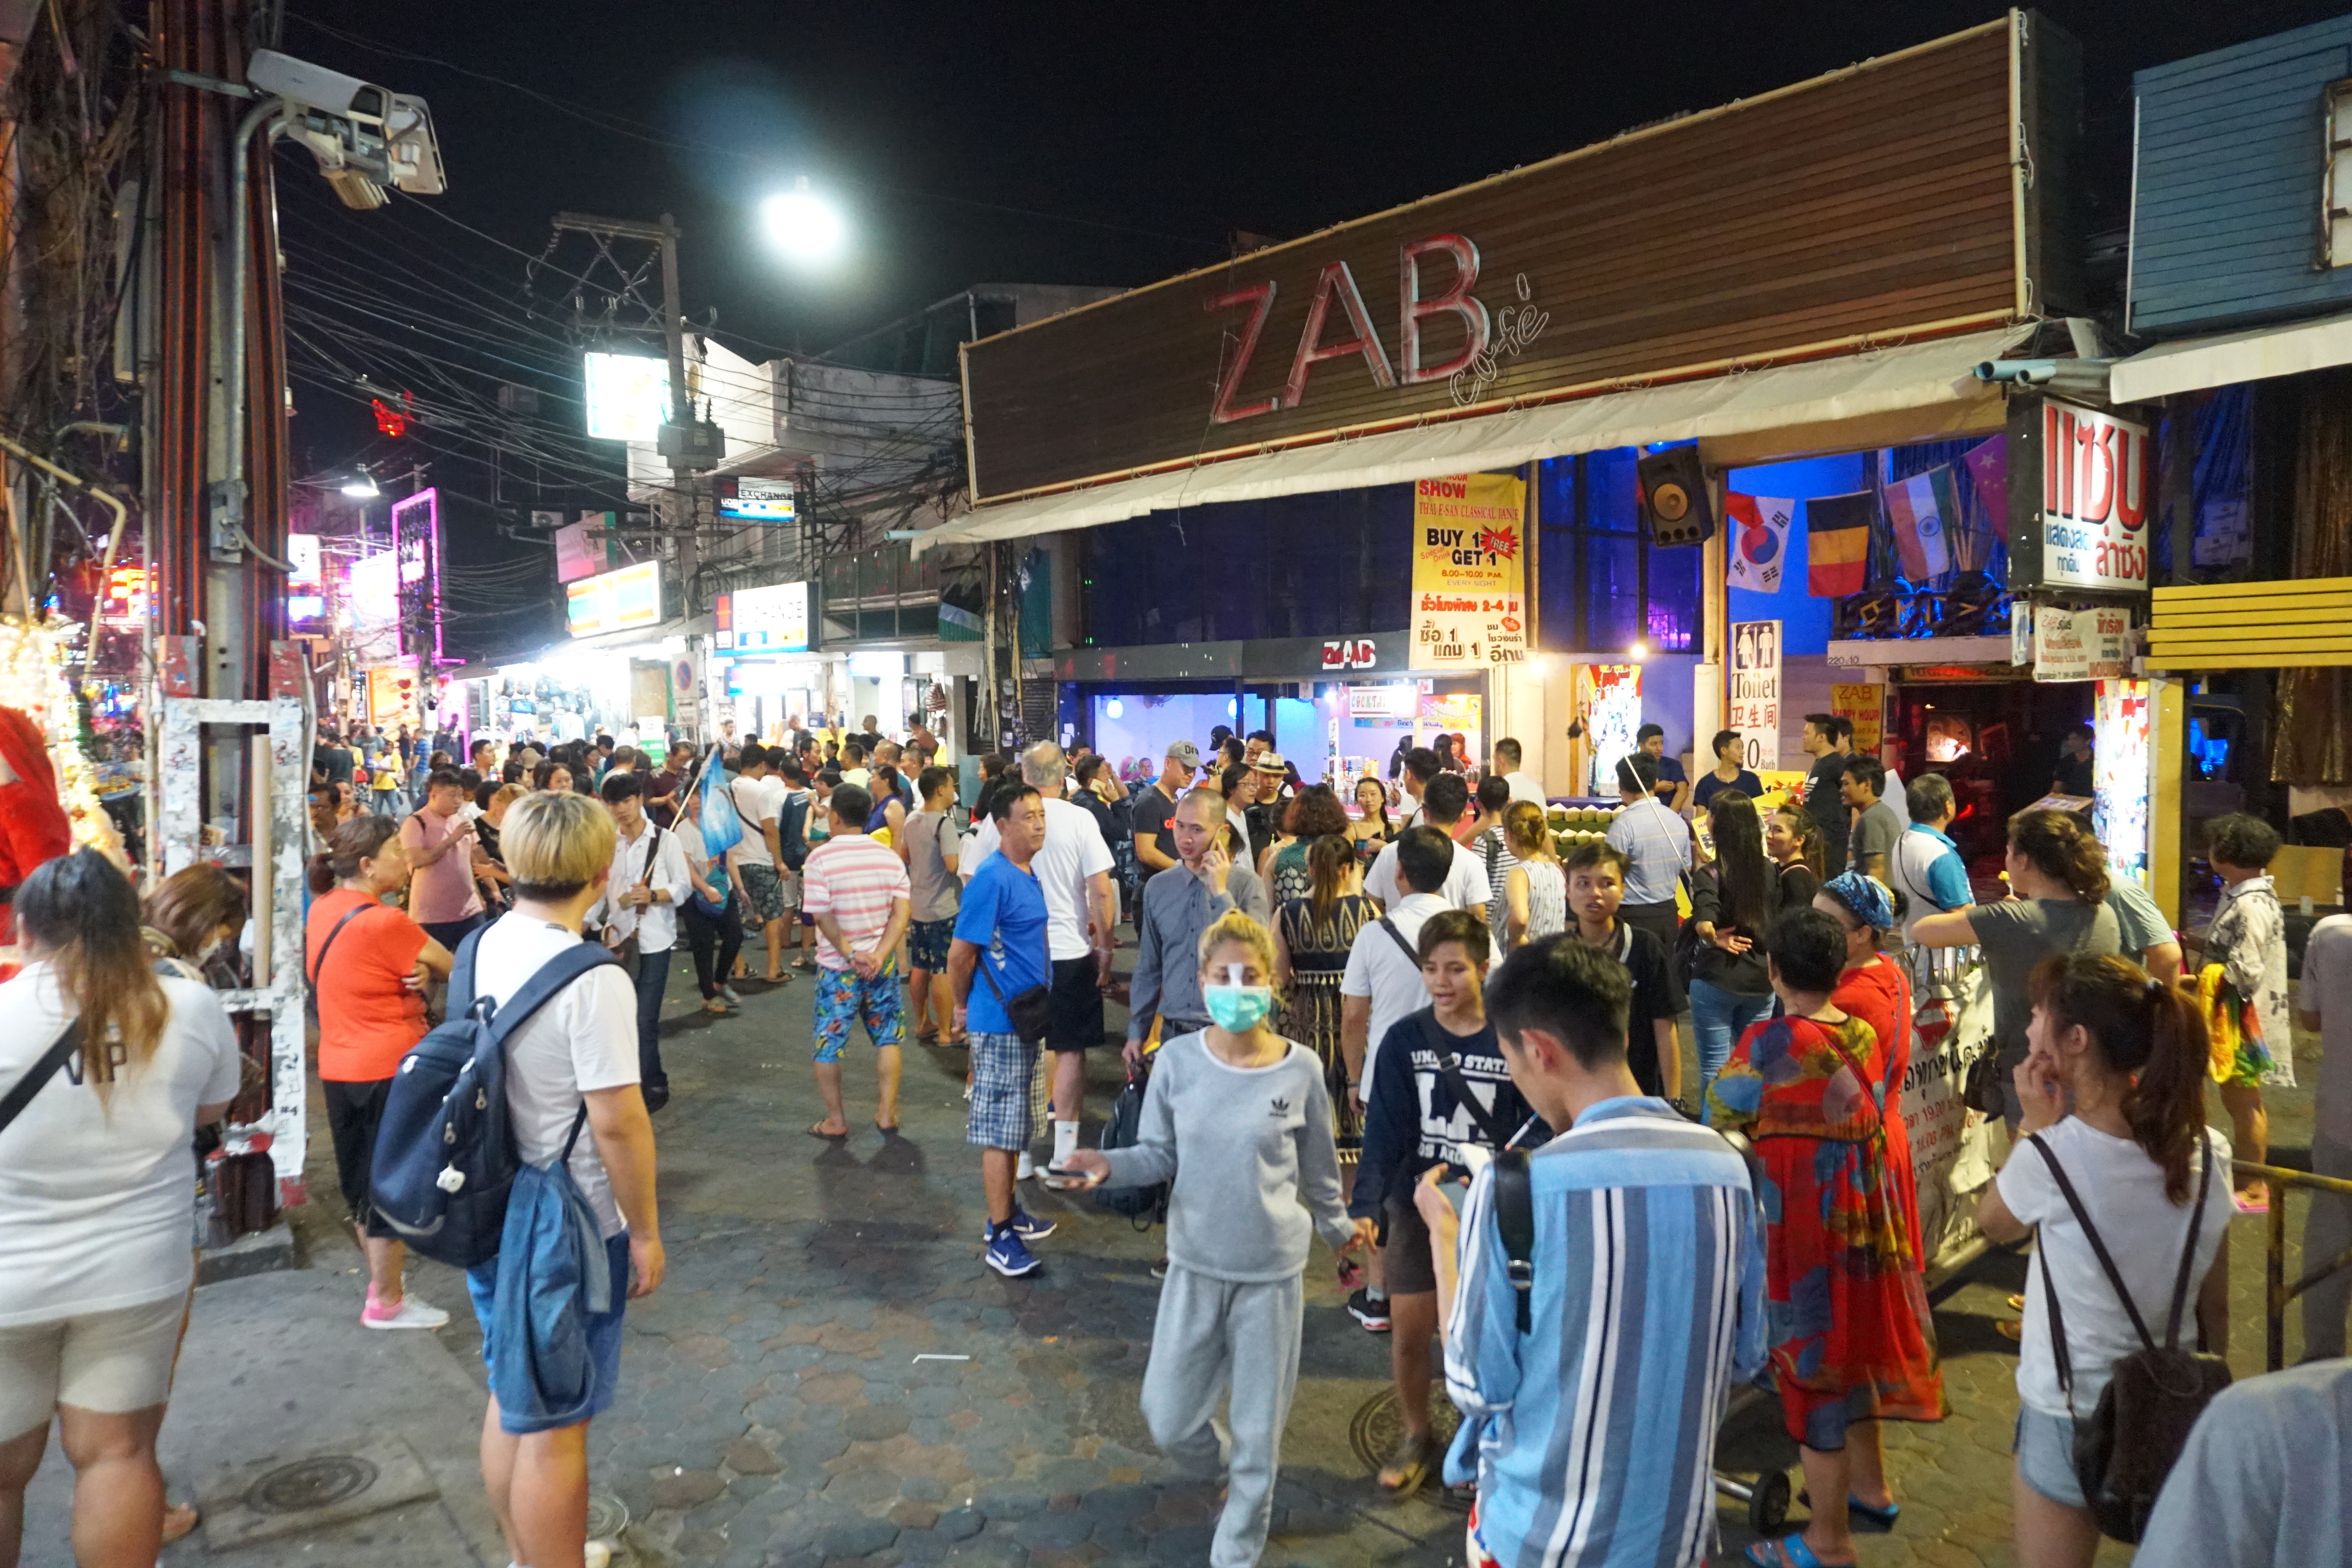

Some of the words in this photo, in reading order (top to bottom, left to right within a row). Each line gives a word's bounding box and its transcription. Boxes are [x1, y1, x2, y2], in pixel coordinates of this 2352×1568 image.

[1204, 234, 1490, 424] ZAB
[2046, 406, 2148, 531] แซบ
[1419, 480, 1466, 499] SHOW
[1419, 502, 1436, 515] THAI
[1461, 506, 1496, 519] CLASSICAL
[1426, 528, 1464, 547] BUY
[1472, 531, 1480, 547] 1
[1489, 536, 1510, 552] FREE
[1421, 546, 1445, 560] Special
[1433, 550, 1451, 562] Drink
[1452, 549, 1482, 566] GET
[1488, 551, 1496, 566] 1
[1482, 600, 1504, 612] 2-4
[1322, 639, 1376, 670] ZAB
[1732, 673, 1776, 699] Toilet
[1838, 686, 1872, 700] ZAB
[1352, 695, 1386, 708] COCKTAI
[1731, 704, 1777, 730] 卫生间
[1761, 759, 1775, 770] Bath
[1411, 1049, 1462, 1066] UNID
